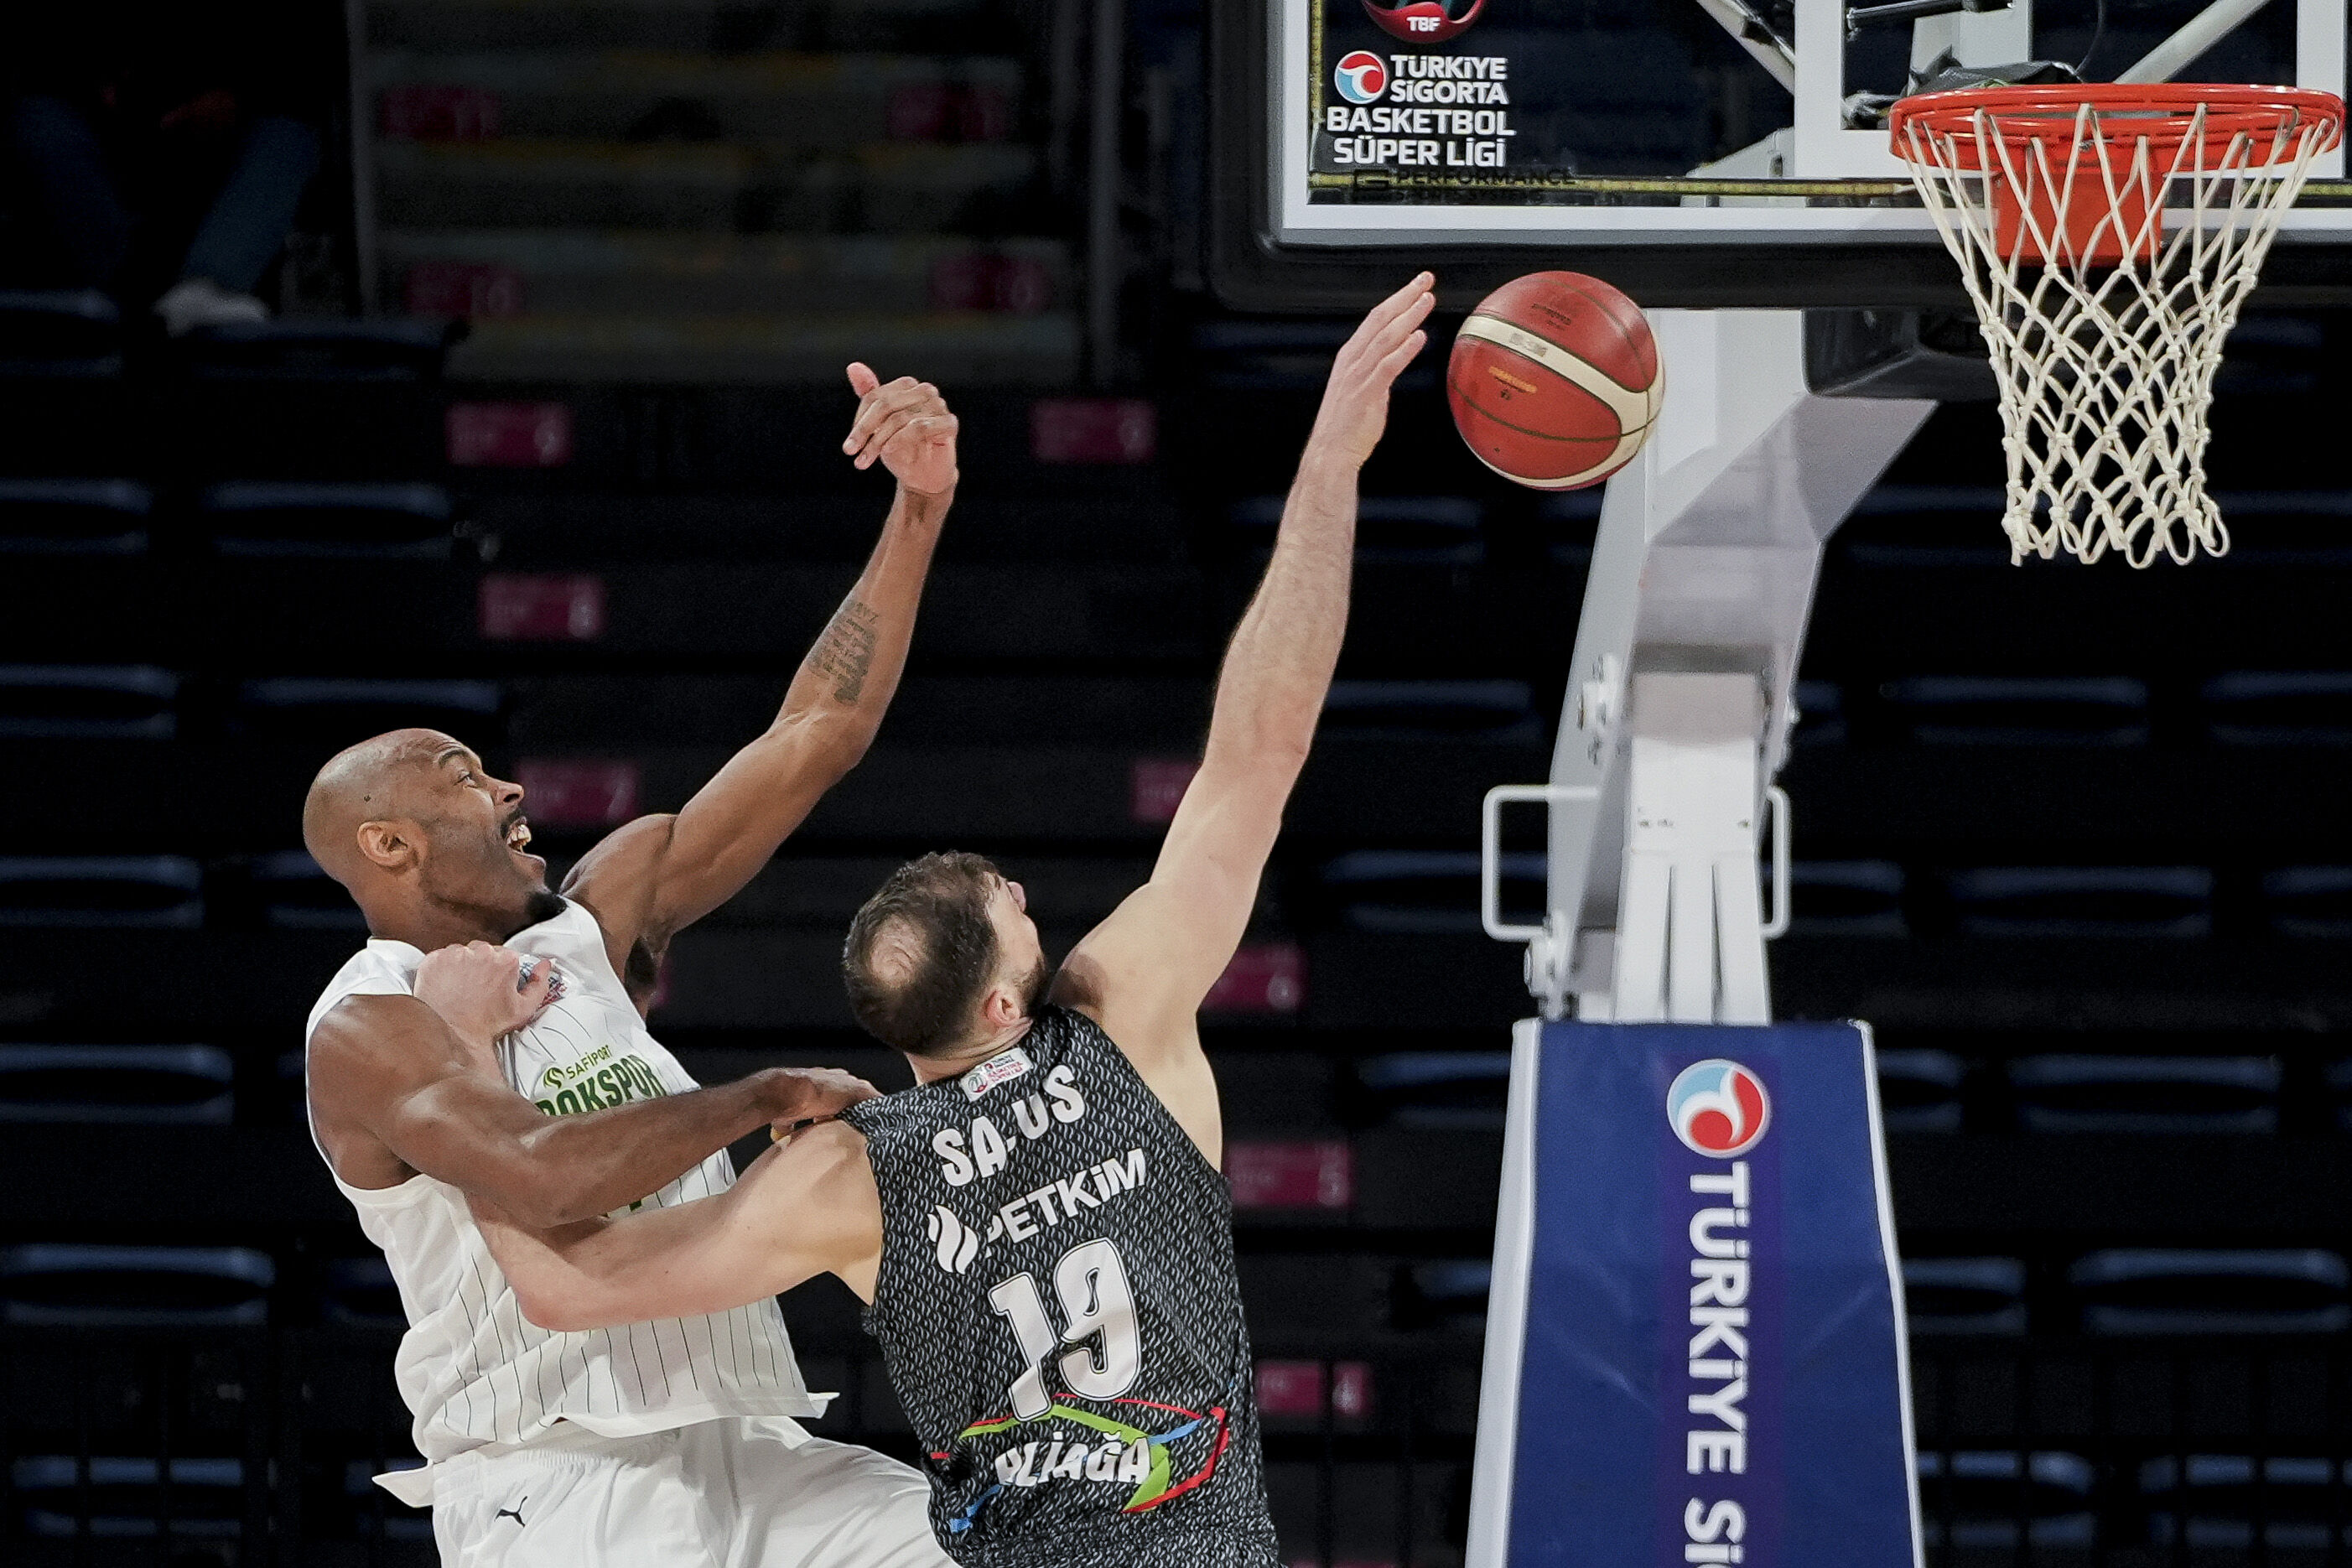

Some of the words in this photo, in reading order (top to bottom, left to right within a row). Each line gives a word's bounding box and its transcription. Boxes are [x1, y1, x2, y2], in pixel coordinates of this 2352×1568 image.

[1406, 17, 1441, 31] TBF
[1390, 55, 1508, 80] TÜRKİYE
[1389, 79, 1509, 104] SİGORTA
[1327, 106, 1517, 136] BASKETBOL
[1333, 135, 1440, 165] SÜPER
[1446, 137, 1507, 167] LİGİ
[1397, 168, 1576, 185] PERFORMANCE
[932, 1064, 1085, 1186] SAUS
[988, 1237, 1140, 1421] 19
[1686, 1161, 1751, 1474] TÜRKİYE
[1685, 1497, 1746, 1568] Sİ
